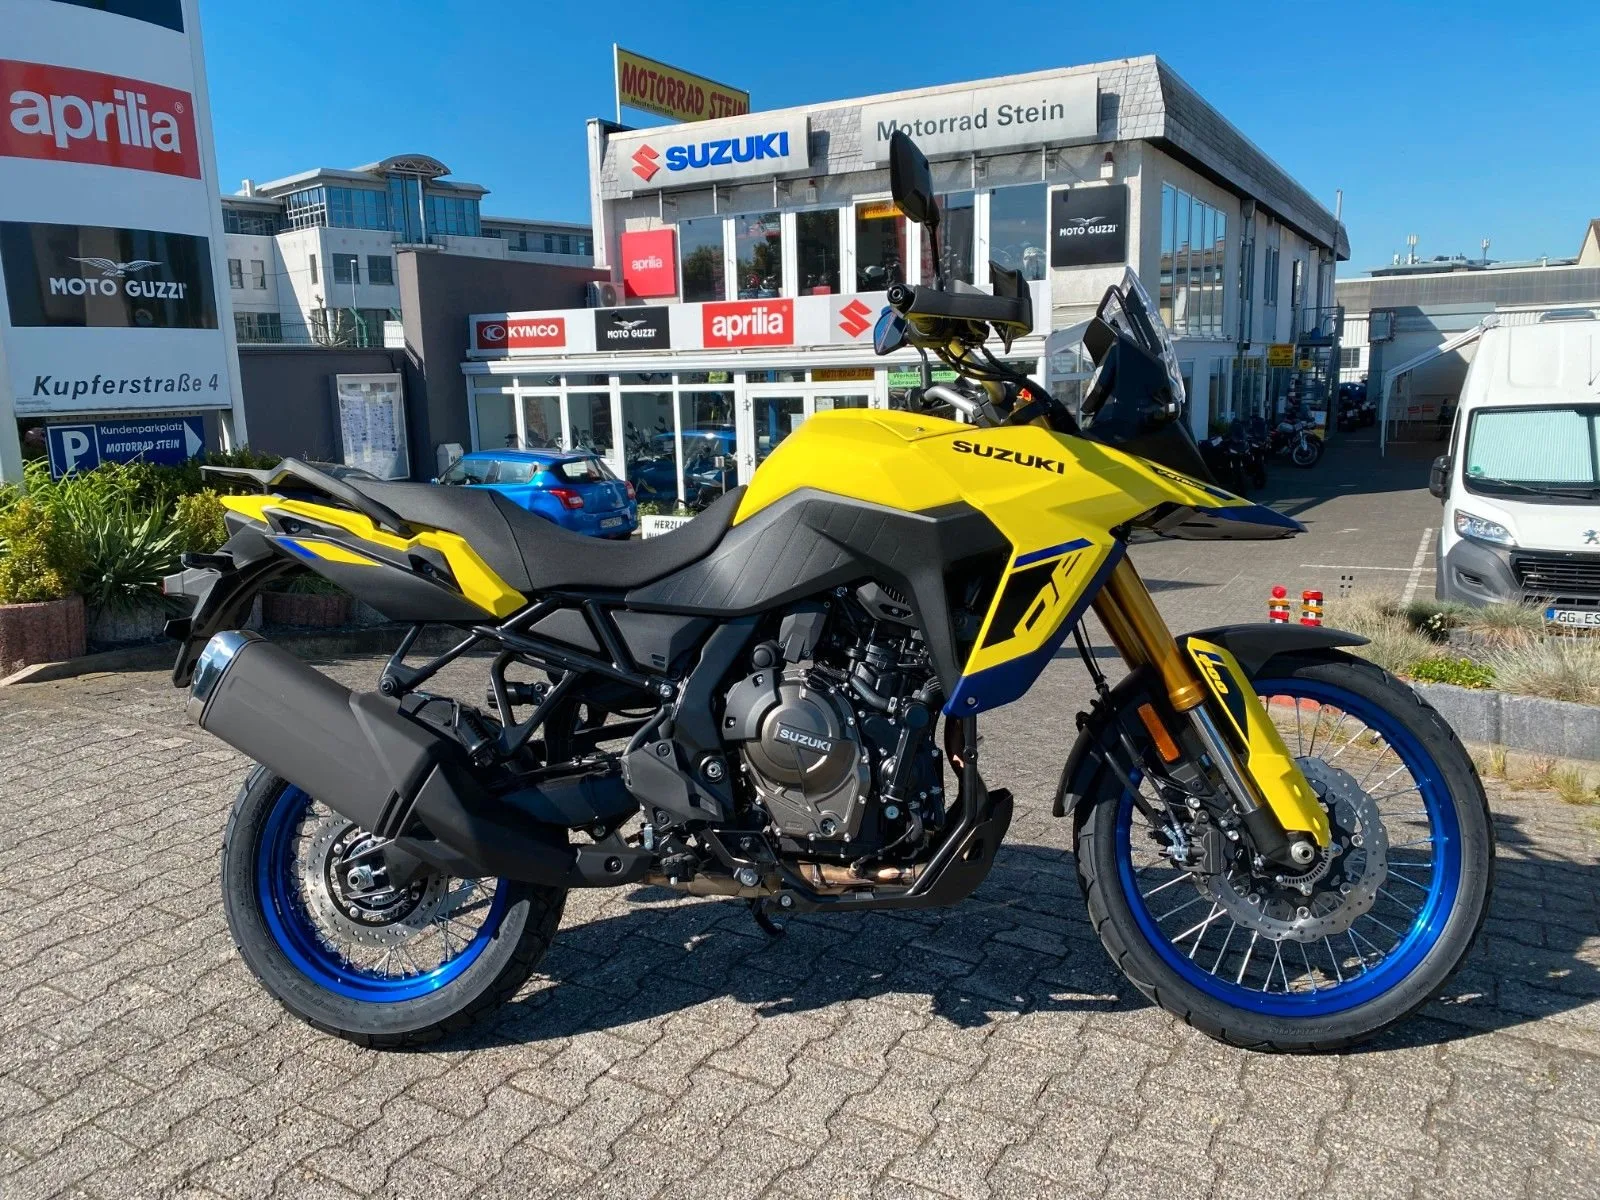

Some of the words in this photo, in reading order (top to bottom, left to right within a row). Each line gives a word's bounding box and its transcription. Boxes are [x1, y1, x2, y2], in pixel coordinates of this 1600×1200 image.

[620, 61, 705, 116] MOTORRAD
[9, 88, 182, 154] aprilia
[877, 108, 988, 142] Motorrad
[997, 99, 1064, 127] Stein
[666, 131, 789, 172] SUZUKI
[1059, 227, 1086, 237] MOTO
[1087, 224, 1117, 234] GUZZI
[631, 255, 663, 271] aprilia
[50, 277, 118, 297] MOTO
[124, 280, 186, 299] GUZZI
[508, 324, 559, 338] KYMCO
[607, 329, 630, 339] MOTO
[630, 328, 657, 338] GUZZI
[712, 307, 784, 342] aprilia
[33, 373, 203, 401] Kupferstraße
[208, 373, 219, 391] 4
[100, 423, 183, 435] Kundenparkplatz
[62, 430, 90, 472] P
[105, 440, 154, 454] MOTORRAD
[155, 439, 181, 450] STEIN
[951, 439, 1065, 475] SUZUKI
[654, 519, 687, 531] HERZLI
[1558, 611, 1576, 623] GG
[779, 728, 832, 752] SUZUKI
